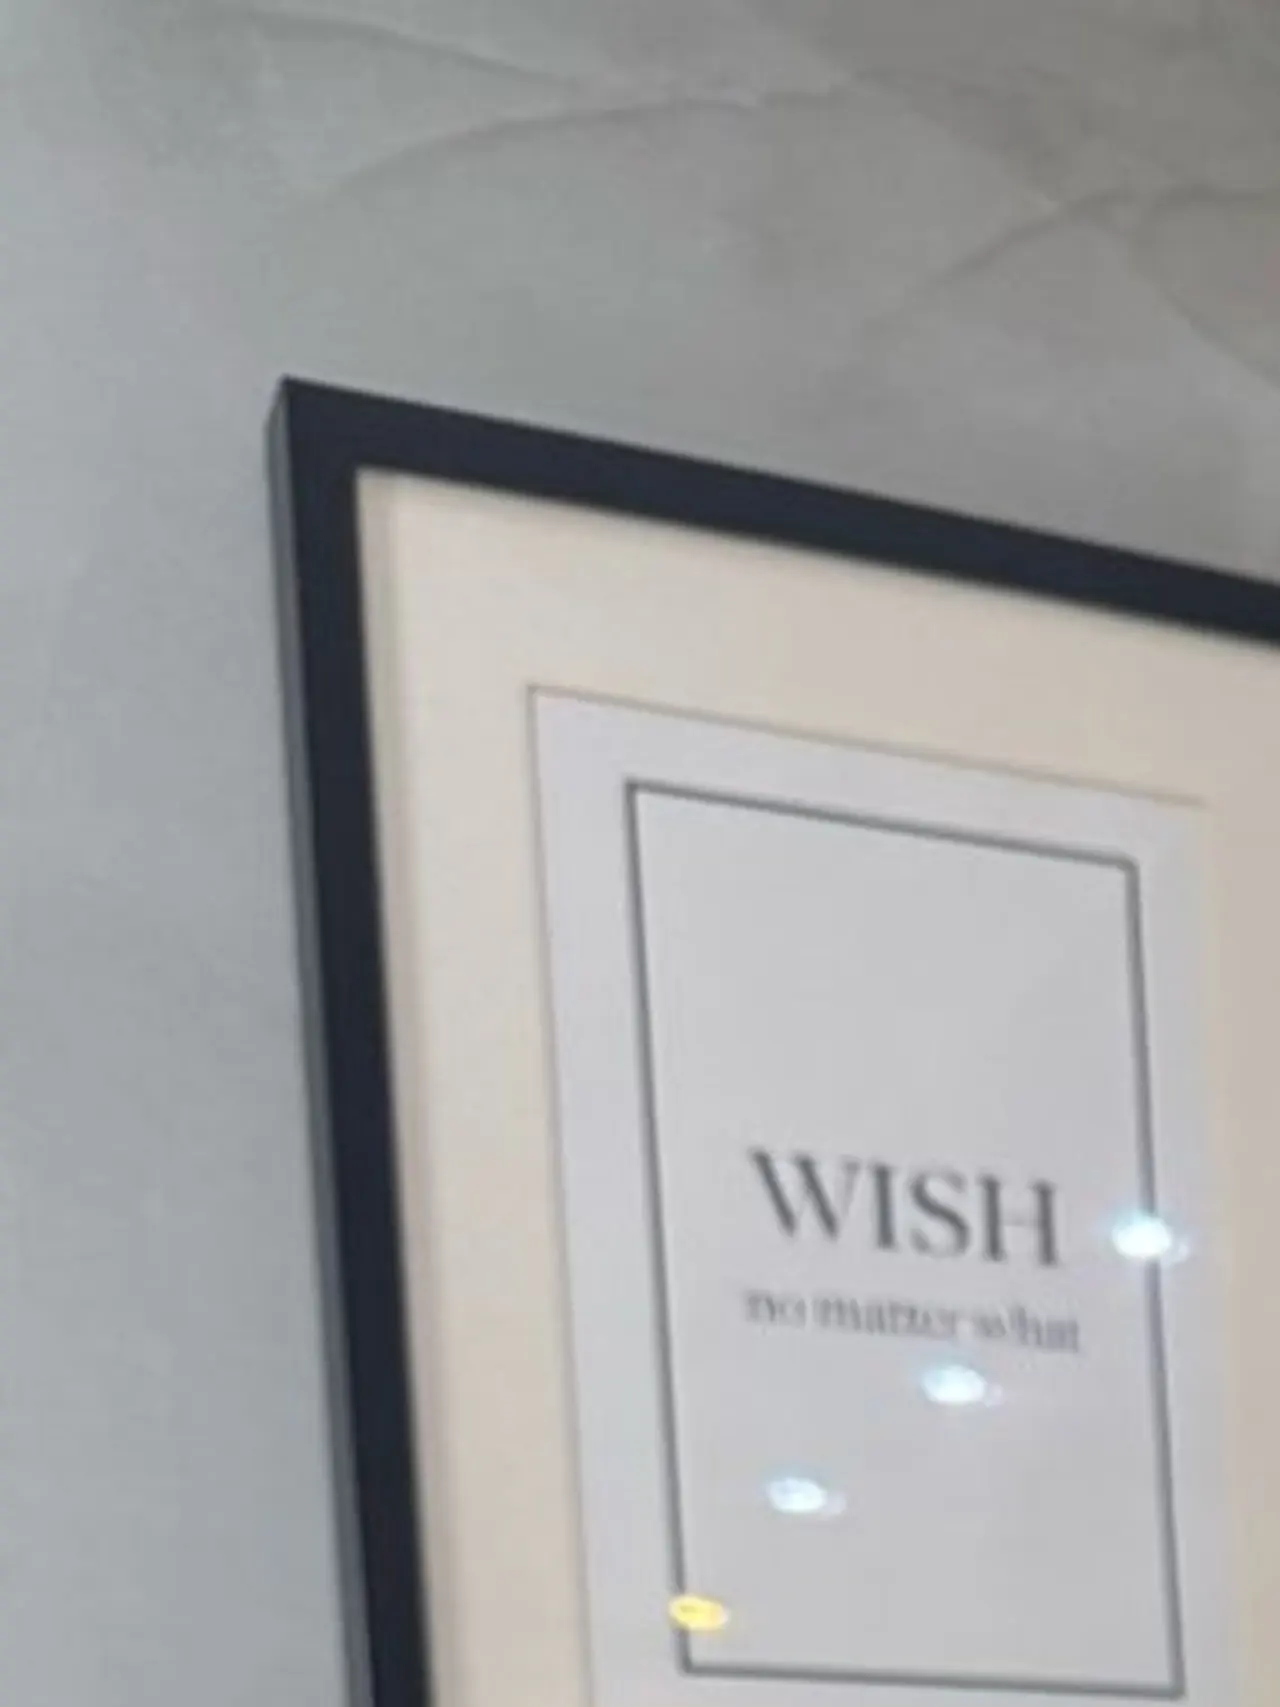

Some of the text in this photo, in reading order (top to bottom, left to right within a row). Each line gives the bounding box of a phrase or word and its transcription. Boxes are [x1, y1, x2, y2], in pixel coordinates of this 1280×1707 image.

[748, 1146, 1058, 1267] WISH
[745, 1290, 1080, 1353] no matter what
